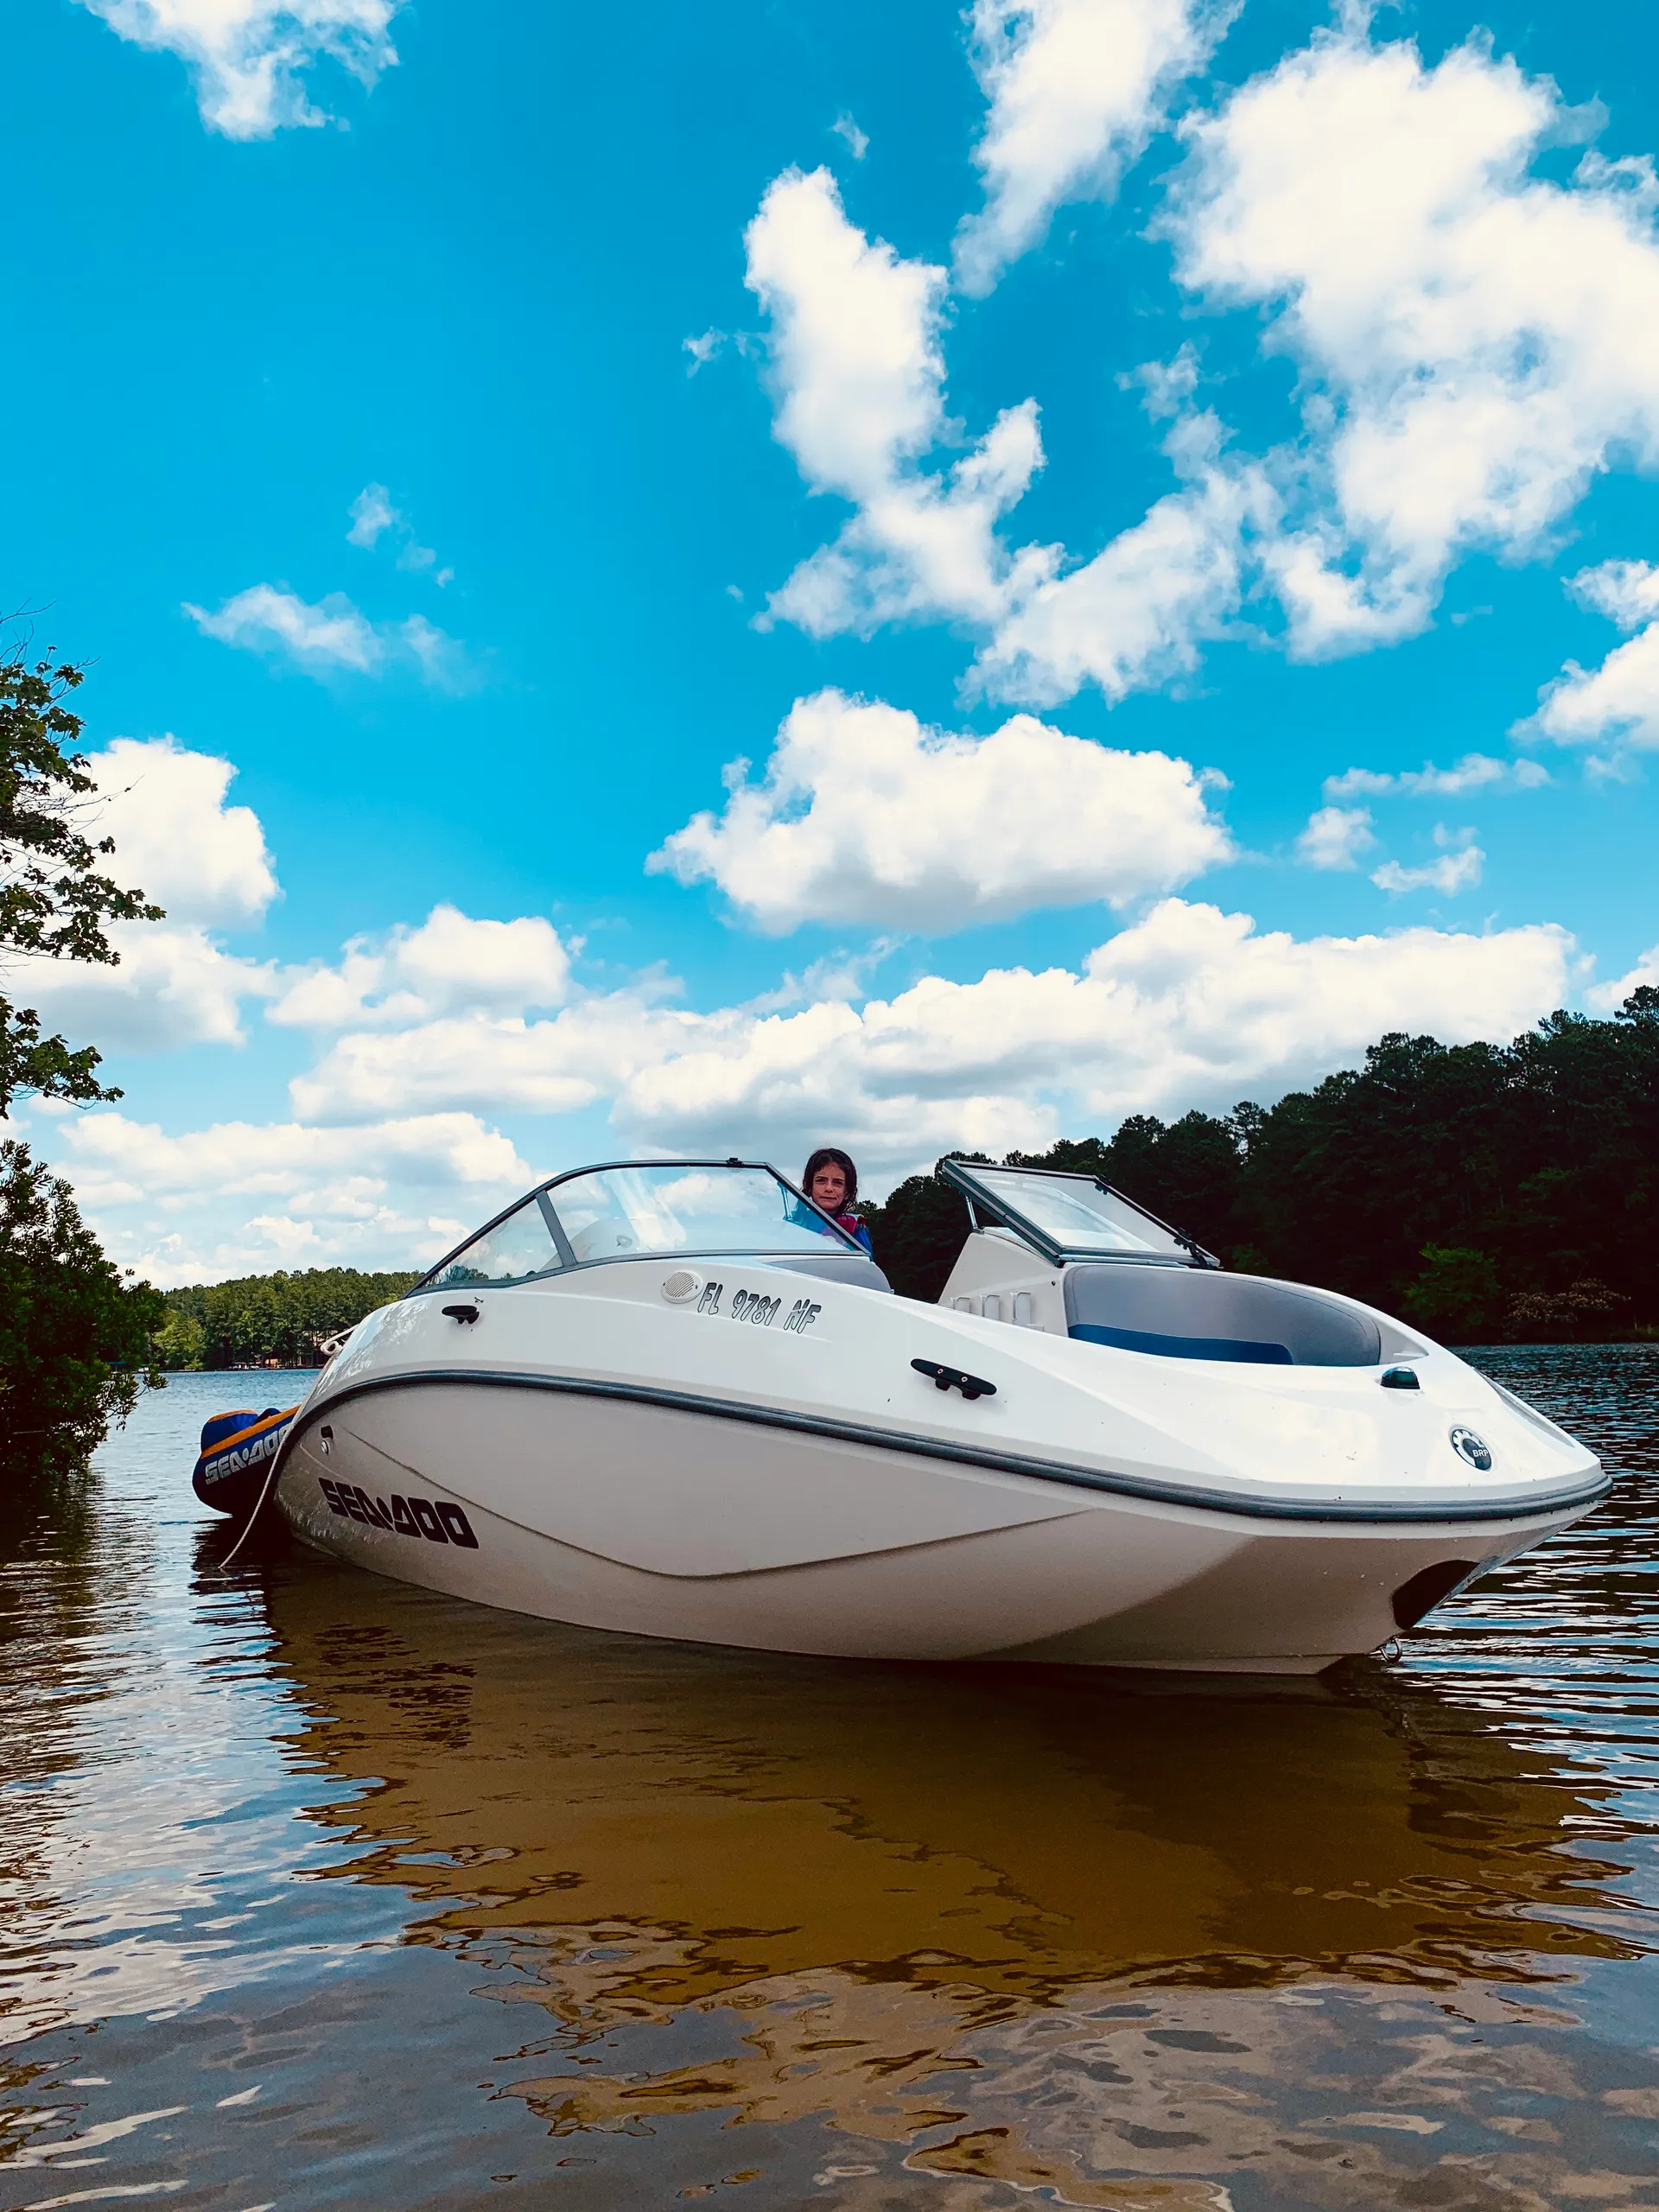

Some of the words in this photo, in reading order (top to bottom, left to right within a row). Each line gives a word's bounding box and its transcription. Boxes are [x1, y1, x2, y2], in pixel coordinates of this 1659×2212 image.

[697, 1282, 723, 1315] FL
[732, 1289, 782, 1325] 9781
[1471, 1449, 1489, 1458] BRP
